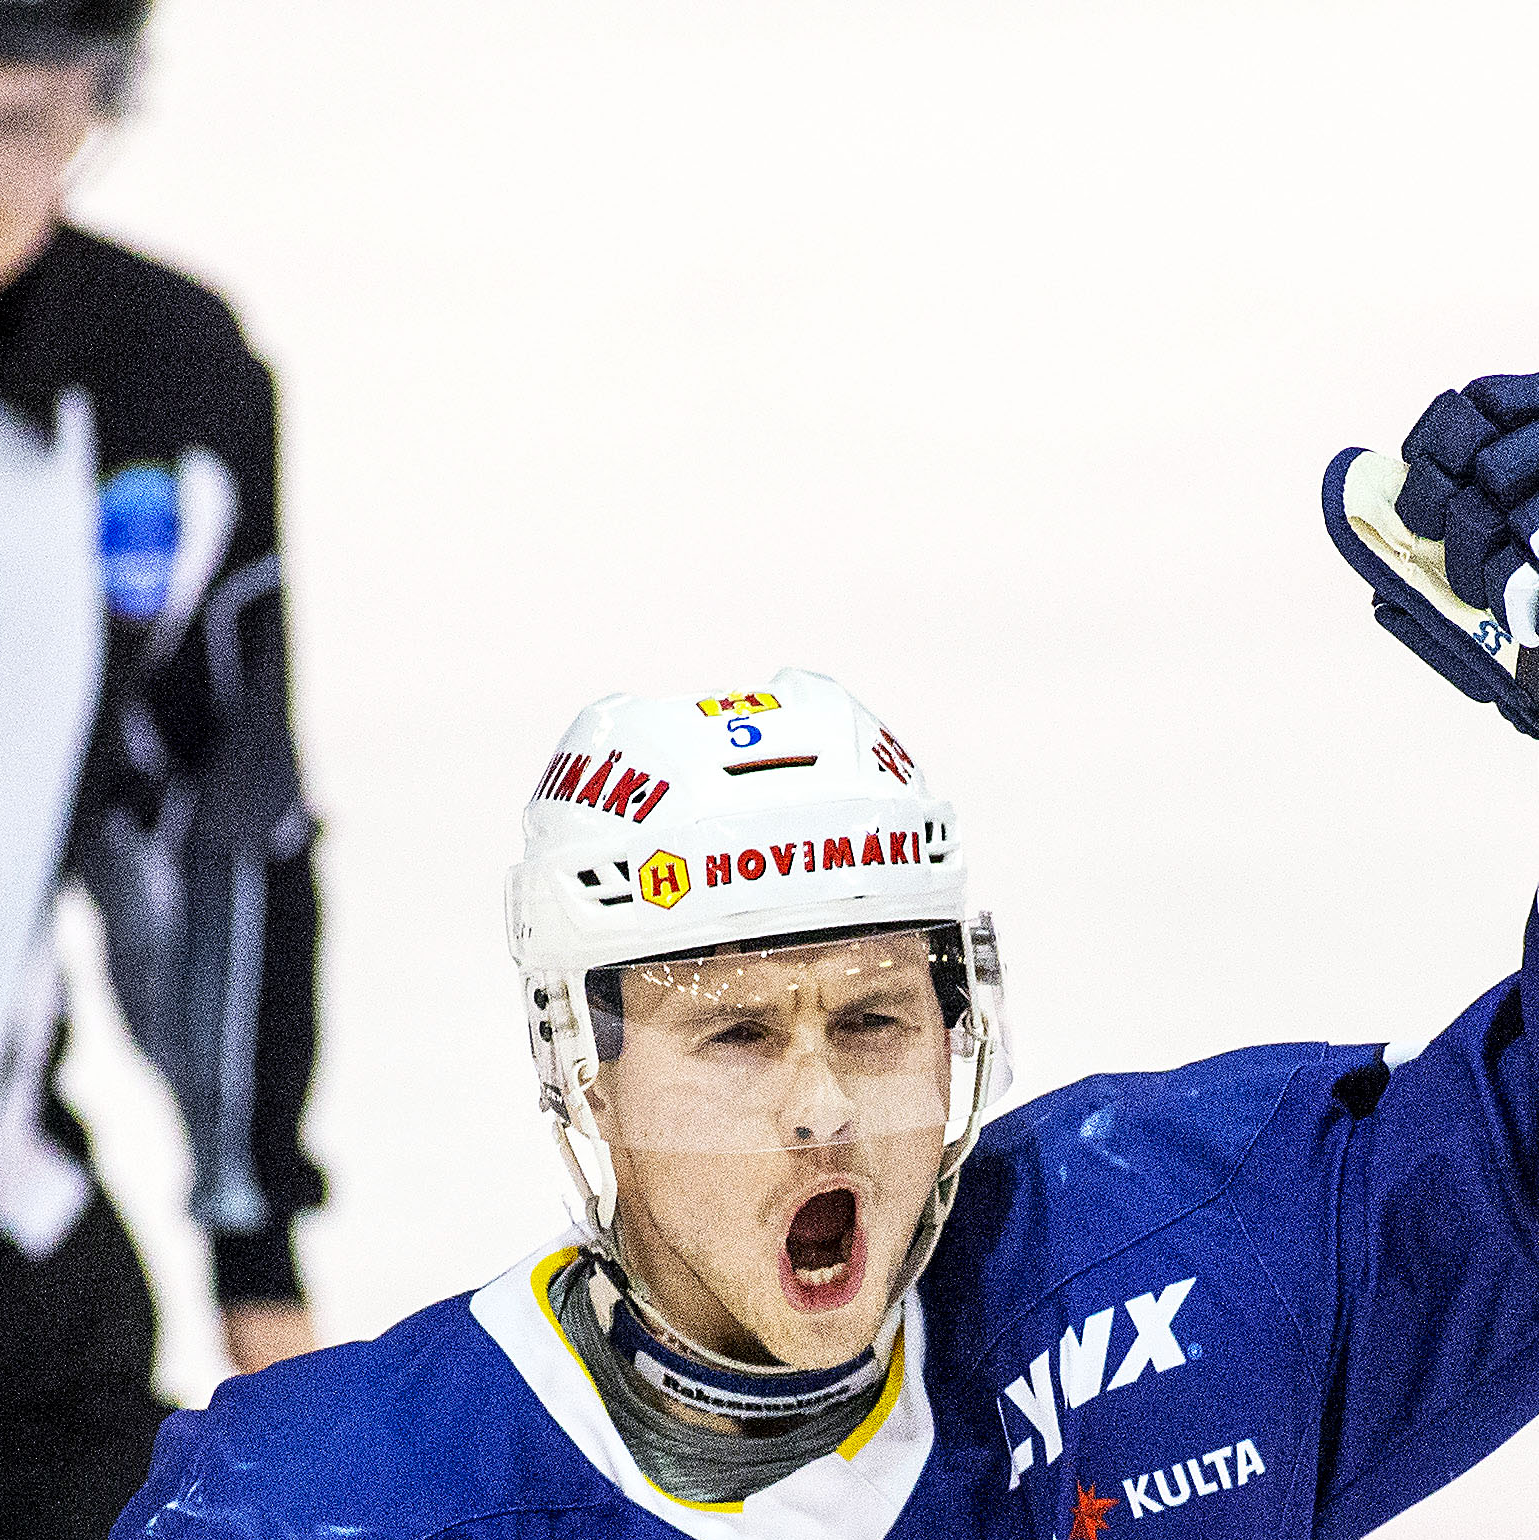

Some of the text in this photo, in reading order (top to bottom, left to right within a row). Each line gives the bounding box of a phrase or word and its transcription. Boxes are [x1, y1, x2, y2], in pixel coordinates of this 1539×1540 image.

[726, 715, 763, 748] 5
[649, 861, 681, 897] H
[1121, 1438, 1266, 1519] KULTA
